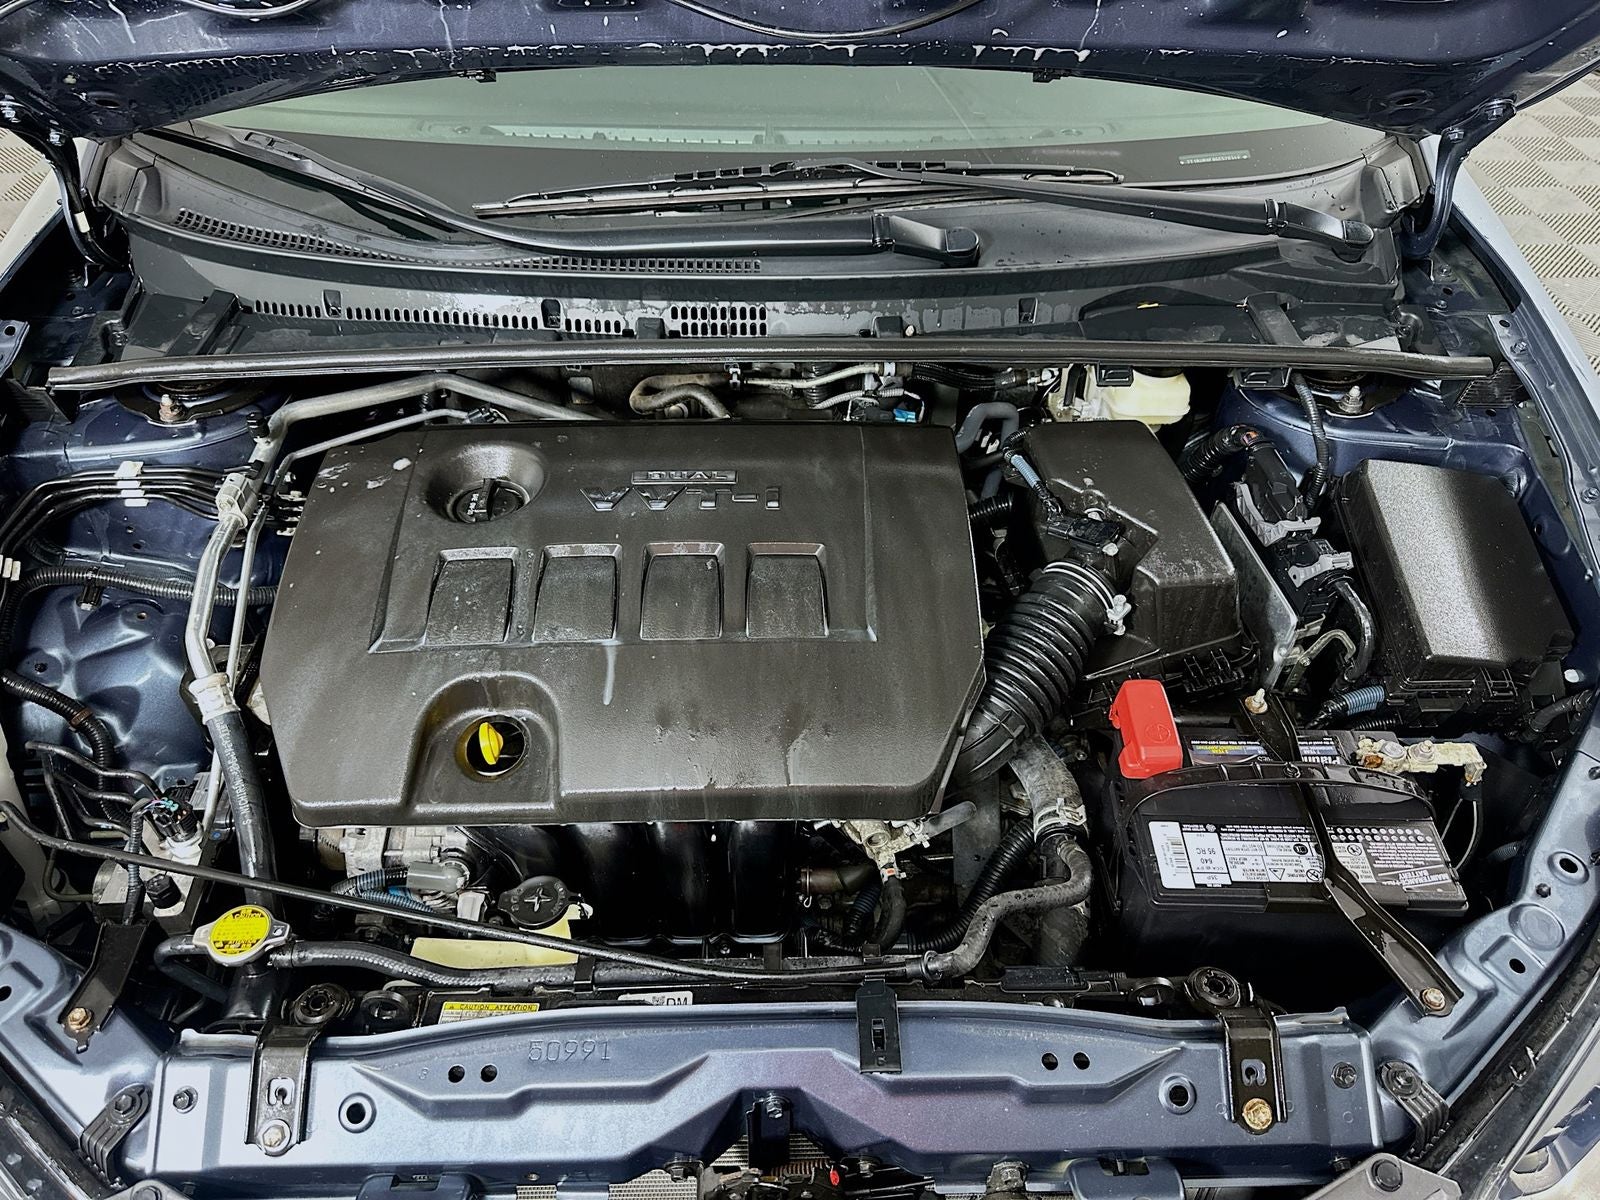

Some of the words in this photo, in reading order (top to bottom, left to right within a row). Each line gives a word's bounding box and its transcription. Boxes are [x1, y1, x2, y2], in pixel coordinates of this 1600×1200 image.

[647, 471, 728, 480] DUAL
[1398, 870, 1429, 880] BATTERY
[495, 1003, 533, 1011] ATTENTION
[528, 1039, 611, 1062] 50991
